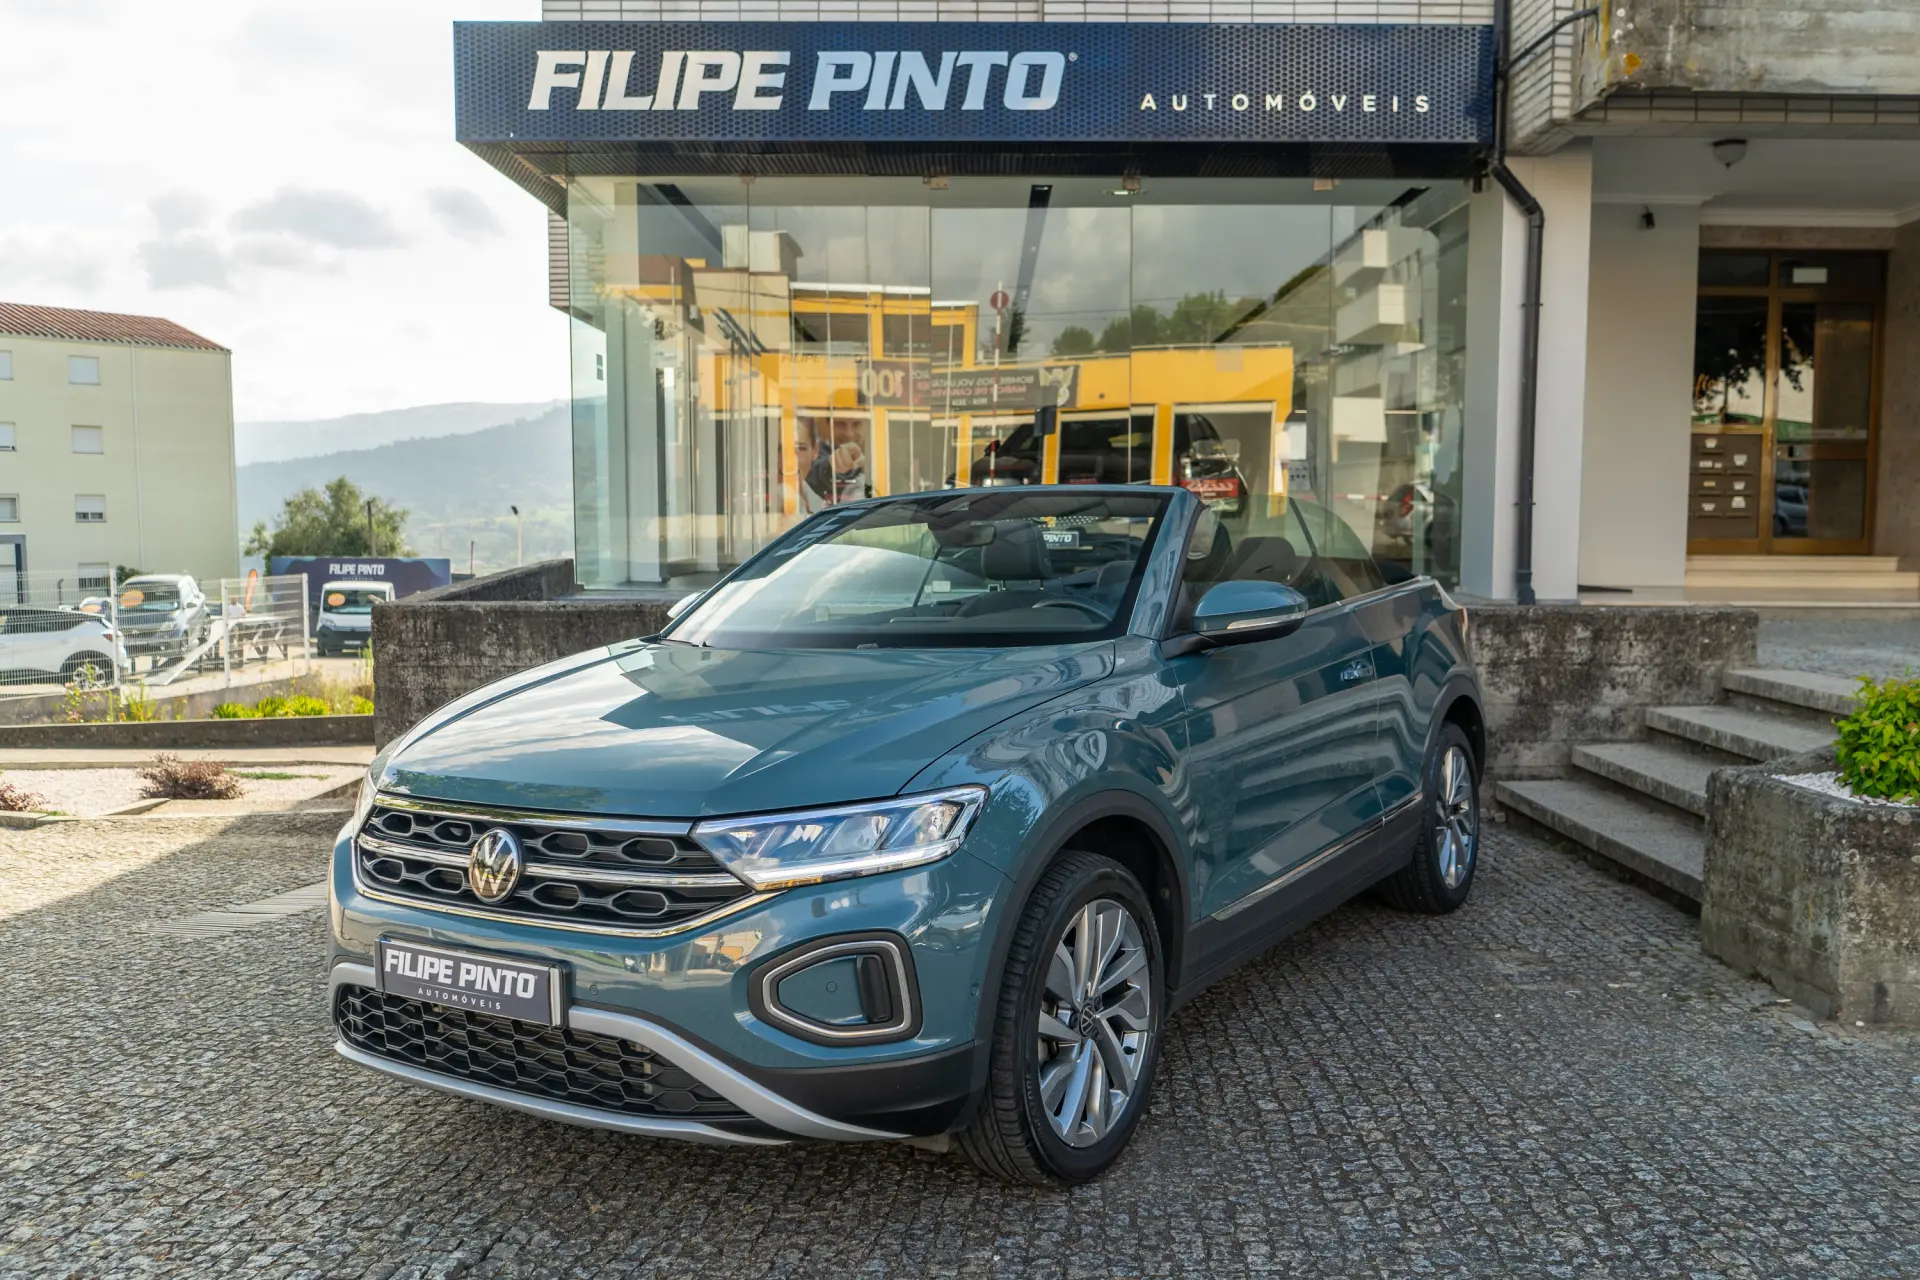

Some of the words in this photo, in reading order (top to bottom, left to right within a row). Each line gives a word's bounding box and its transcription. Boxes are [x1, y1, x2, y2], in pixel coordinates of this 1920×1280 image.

[527, 50, 791, 111] FILIPE
[807, 50, 1067, 111] PINTO
[1140, 89, 1430, 113] AUTOMÓVEIS
[329, 563, 357, 575] FILIPE
[357, 563, 385, 576] PINTO
[384, 948, 454, 986] FILIPE
[458, 962, 536, 999] PINTO
[418, 987, 501, 1010] AUTOMÓVEIS
